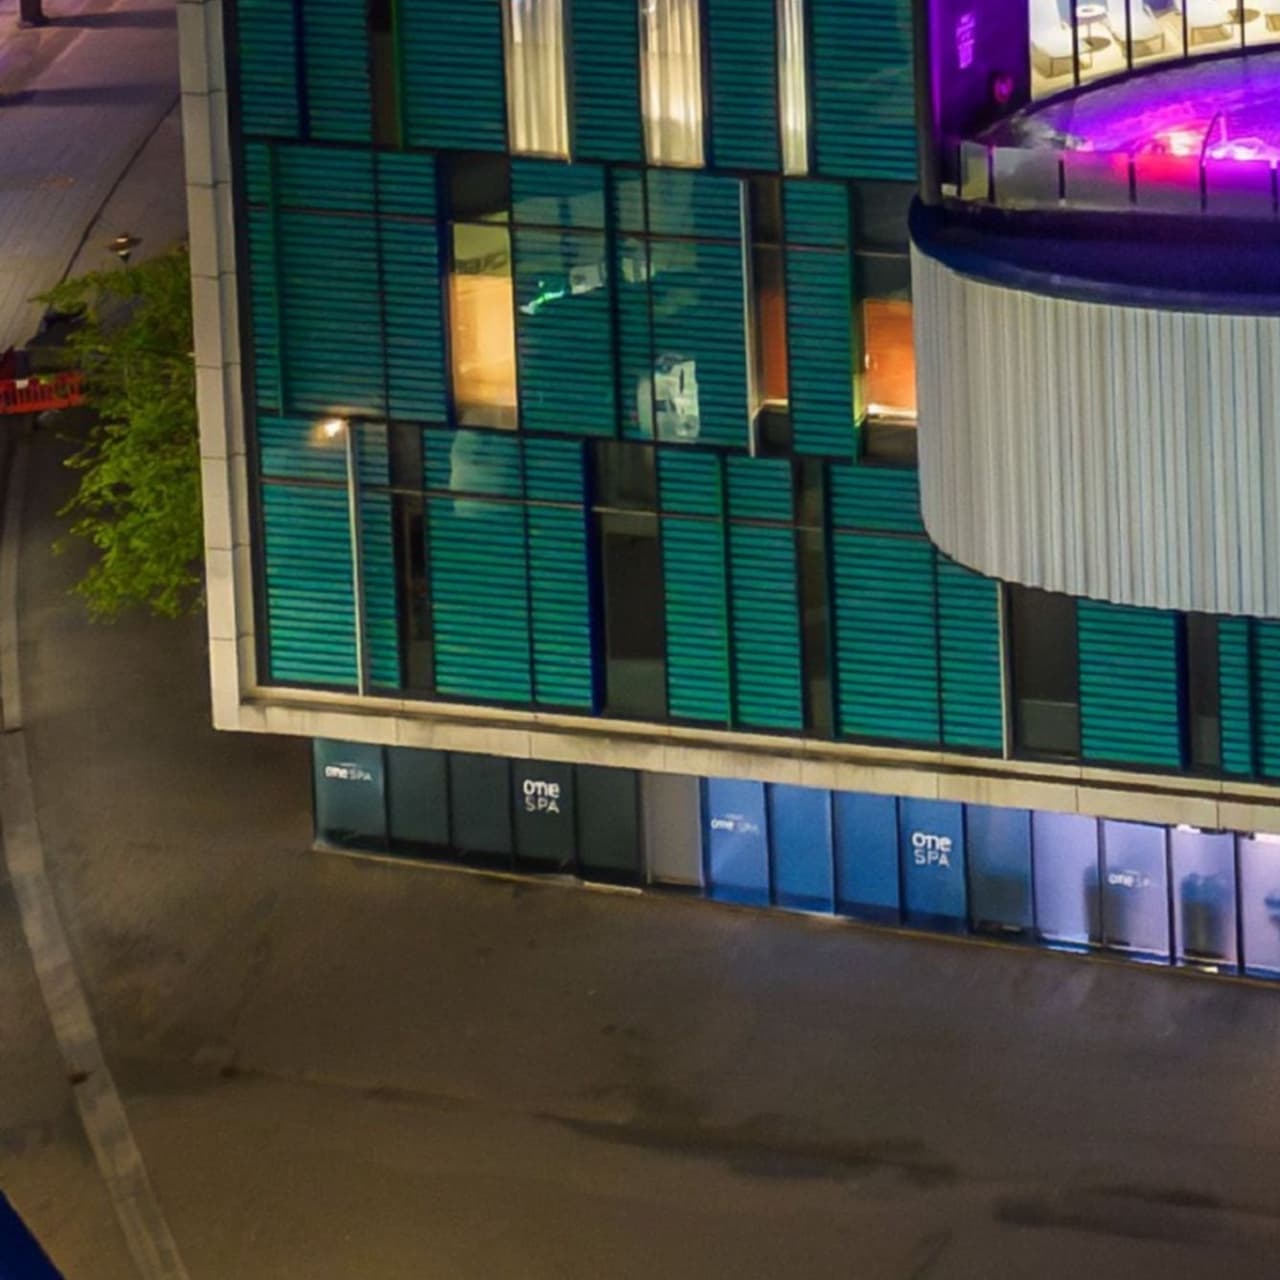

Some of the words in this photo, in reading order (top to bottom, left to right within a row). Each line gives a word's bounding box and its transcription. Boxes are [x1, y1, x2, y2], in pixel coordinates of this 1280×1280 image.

[523, 779, 560, 799] one
[524, 796, 560, 814] SPA
[912, 832, 952, 852] one
[914, 848, 951, 869] SPA
